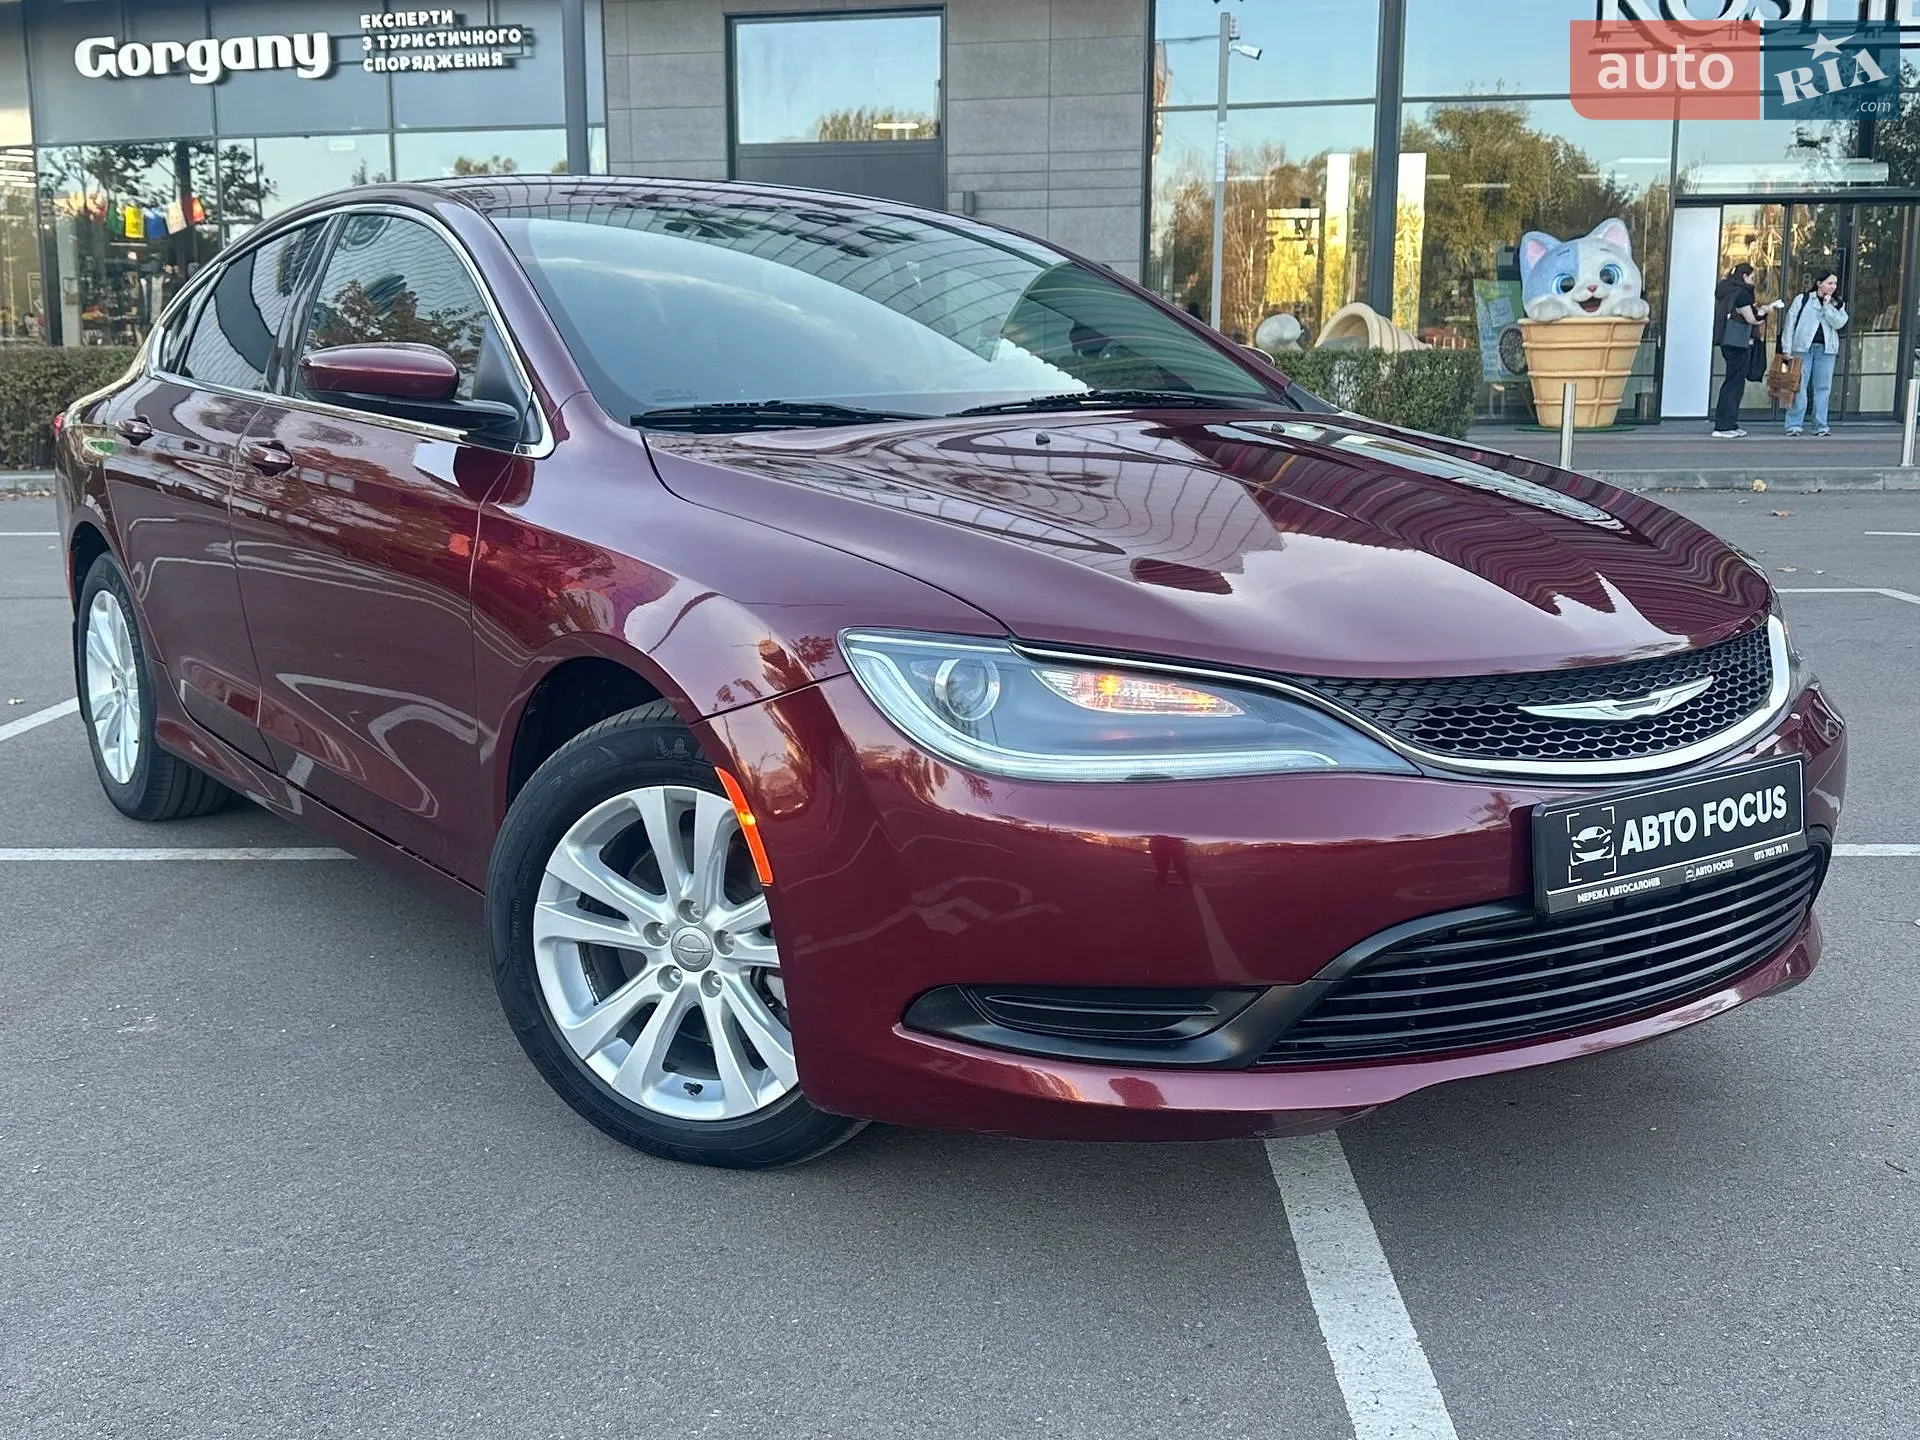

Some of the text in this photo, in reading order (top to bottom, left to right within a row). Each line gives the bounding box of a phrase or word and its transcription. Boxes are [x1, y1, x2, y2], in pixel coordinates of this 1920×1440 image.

[360, 9, 453, 29] ЕКСПЕРТИ
[377, 28, 522, 49] ТУРИСТИЧНОГО
[75, 32, 330, 84] Gorgany
[362, 52, 503, 72] СПОРЯДЖЕННЯ
[1621, 785, 1787, 856] АВТО FOCUS
[1713, 859, 1734, 872] FOCUS
[1577, 877, 1661, 903] МЕРЕЖА АВТОСАЛОНІВ
